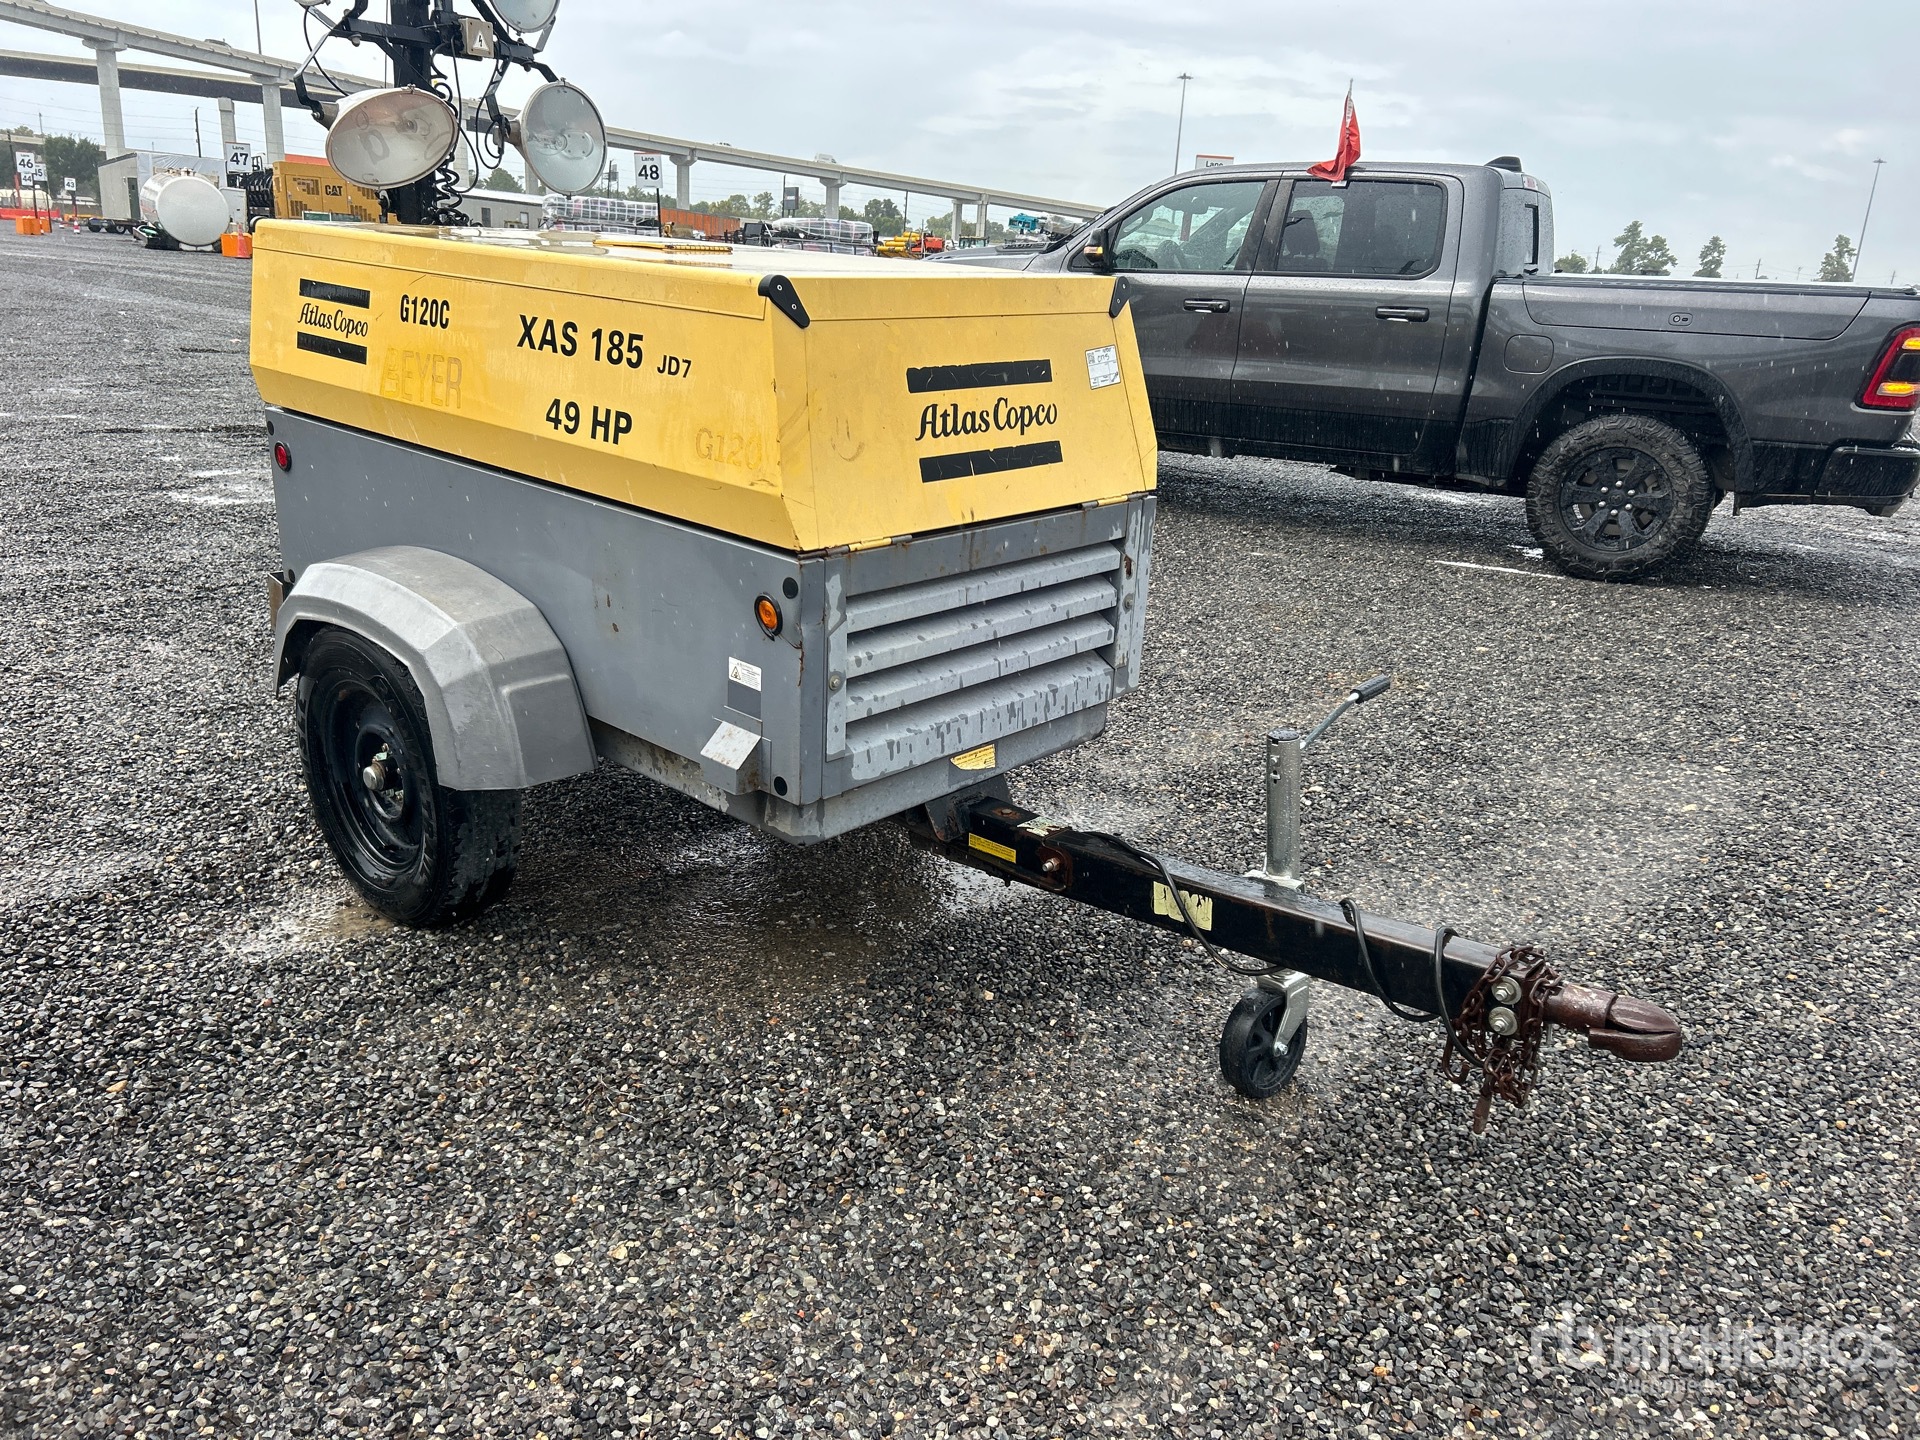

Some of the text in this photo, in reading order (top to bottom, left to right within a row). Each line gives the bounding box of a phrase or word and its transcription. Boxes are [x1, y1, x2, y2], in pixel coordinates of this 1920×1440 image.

[19, 159, 33, 168] 46
[230, 152, 249, 166] 47
[638, 165, 659, 180] 48
[325, 185, 343, 196] CAT
[298, 303, 369, 338] Atlas Copco
[400, 294, 450, 329] G120C
[517, 314, 692, 378] XAS 185 JD7
[545, 398, 633, 446] 49 HP
[915, 397, 1058, 441] Atlas Copco
